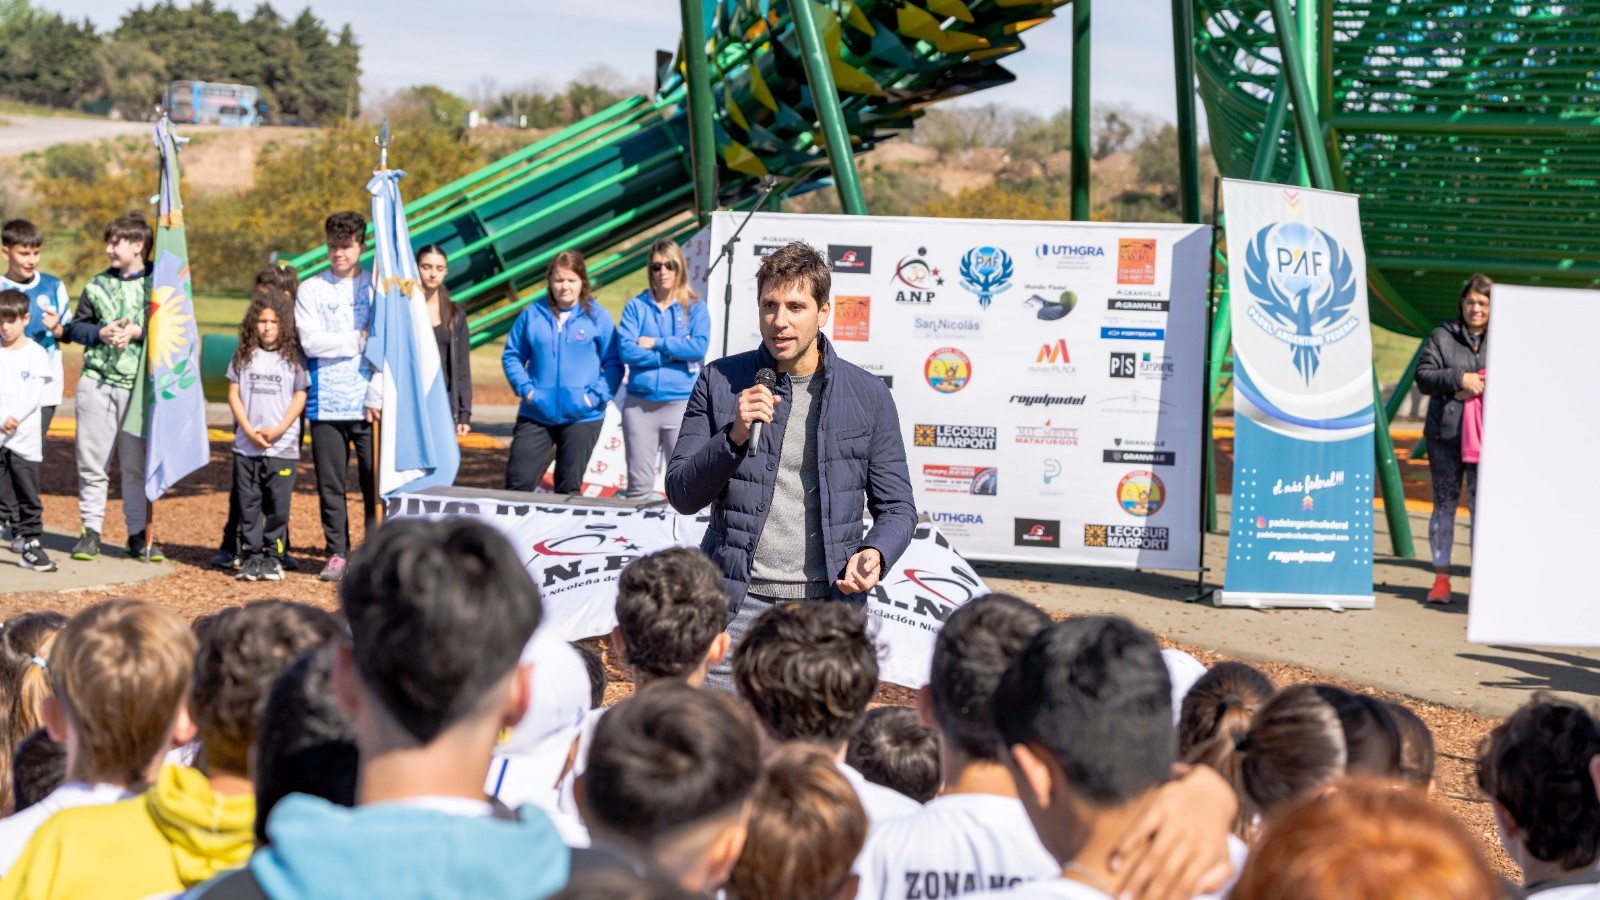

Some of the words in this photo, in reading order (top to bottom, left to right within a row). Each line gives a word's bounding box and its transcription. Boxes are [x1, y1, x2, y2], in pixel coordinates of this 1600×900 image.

[1052, 245, 1104, 256] UTHGRA
[895, 291, 936, 303] A.N.P
[1122, 301, 1162, 310] GRANVILLE
[914, 318, 937, 332] San
[937, 319, 980, 331] Nicolás
[1248, 307, 1274, 334] PADEL
[1275, 329, 1325, 346] ARGENTINO
[1327, 317, 1359, 343] FEDERAL
[1009, 394, 1087, 407] royalpadel
[936, 426, 996, 438] LECOSUR
[936, 437, 995, 450] MARPORT
[1015, 438, 1078, 446] MATAFUEGOS
[1124, 439, 1166, 447] GRANVILLE
[1122, 453, 1166, 462] GRANVILLE
[932, 513, 984, 524] UTHGRA
[1107, 525, 1168, 539] LECOSUR
[1107, 537, 1168, 550] MARPORT
[549, 578, 600, 597] Nicoleña
[904, 871, 976, 900] ZONA
